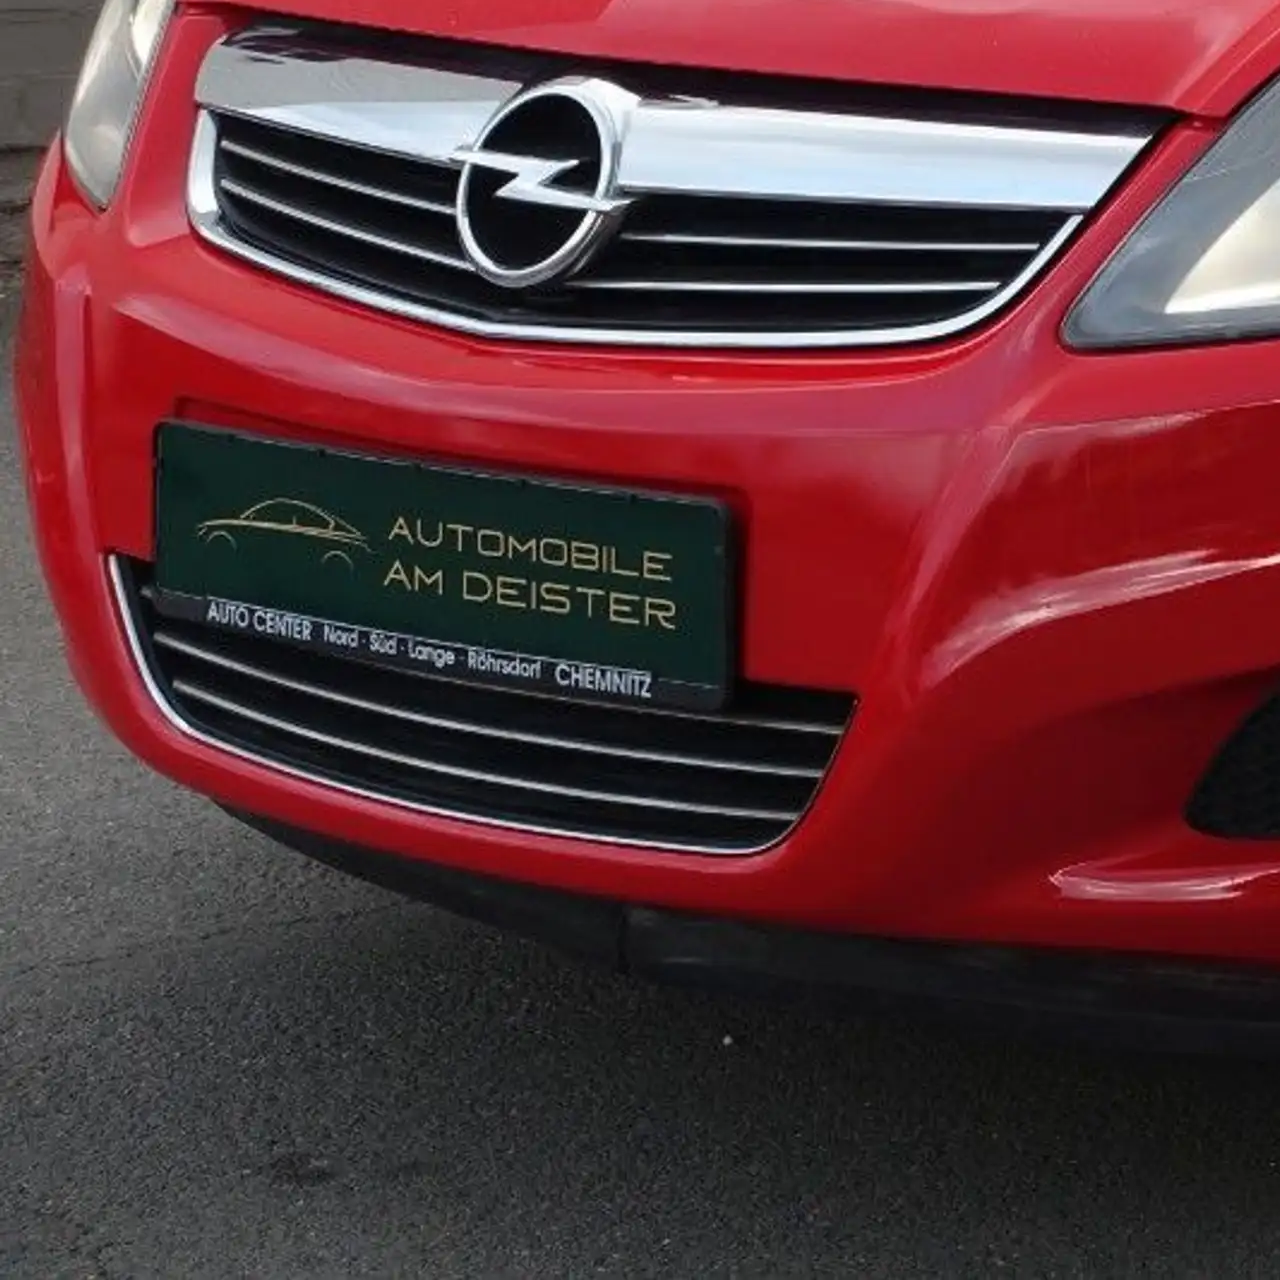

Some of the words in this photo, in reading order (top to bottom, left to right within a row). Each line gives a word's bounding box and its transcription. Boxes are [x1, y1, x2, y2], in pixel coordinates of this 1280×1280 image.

[388, 516, 674, 582] AUTOMOBILE
[384, 559, 444, 596] AM
[462, 570, 677, 630] DEISTER
[206, 601, 249, 627] AUTO
[253, 610, 314, 641] CENTER
[323, 624, 358, 649] Nord
[369, 631, 398, 656] Süd
[407, 642, 455, 668] Lange
[467, 648, 542, 680] Röhrsdorf
[554, 663, 653, 699] CHEMNITZ
